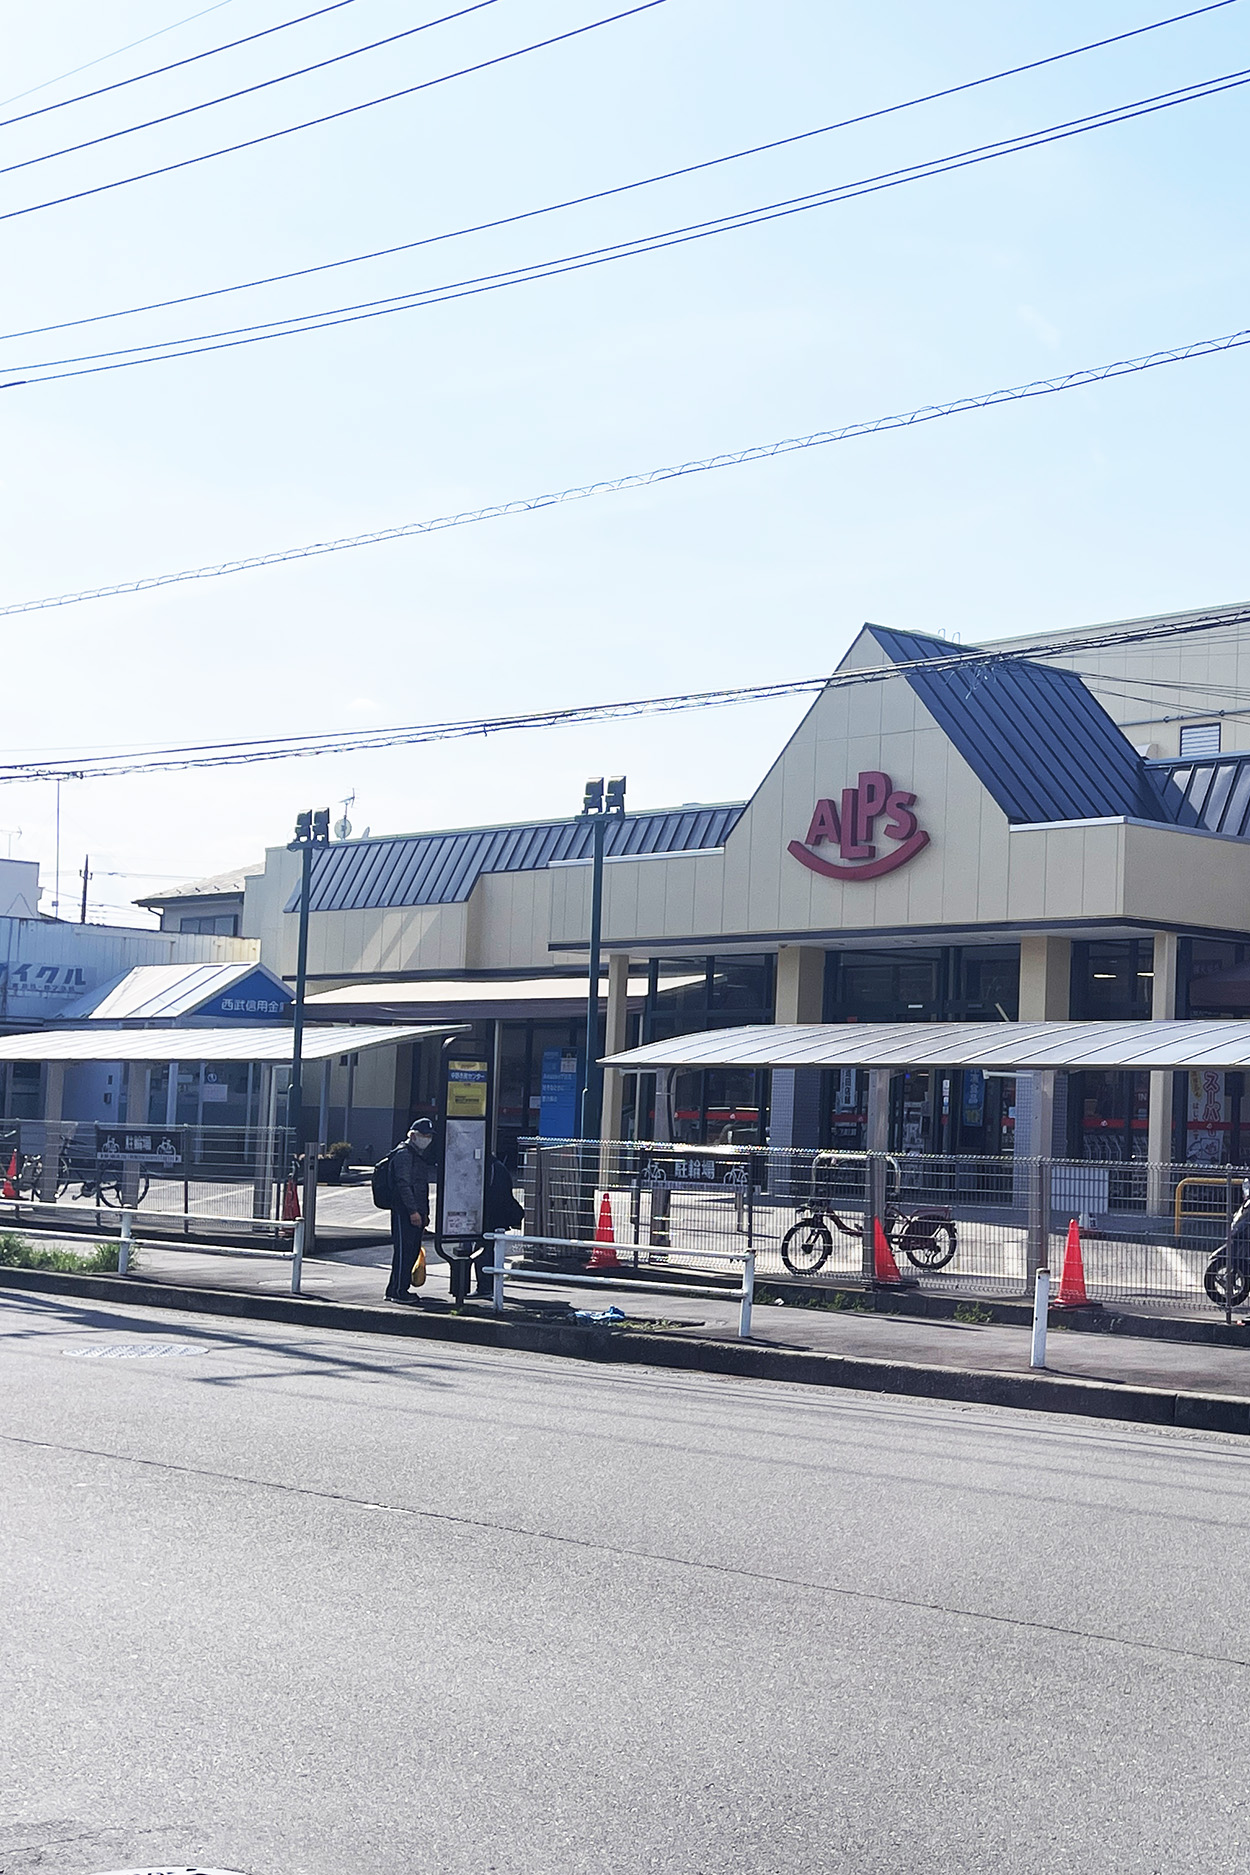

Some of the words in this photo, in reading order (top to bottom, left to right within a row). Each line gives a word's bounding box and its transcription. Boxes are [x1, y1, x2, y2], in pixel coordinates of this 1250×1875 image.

[805, 771, 917, 860] ALPS
[674, 1159, 715, 1180] 駐輪場
